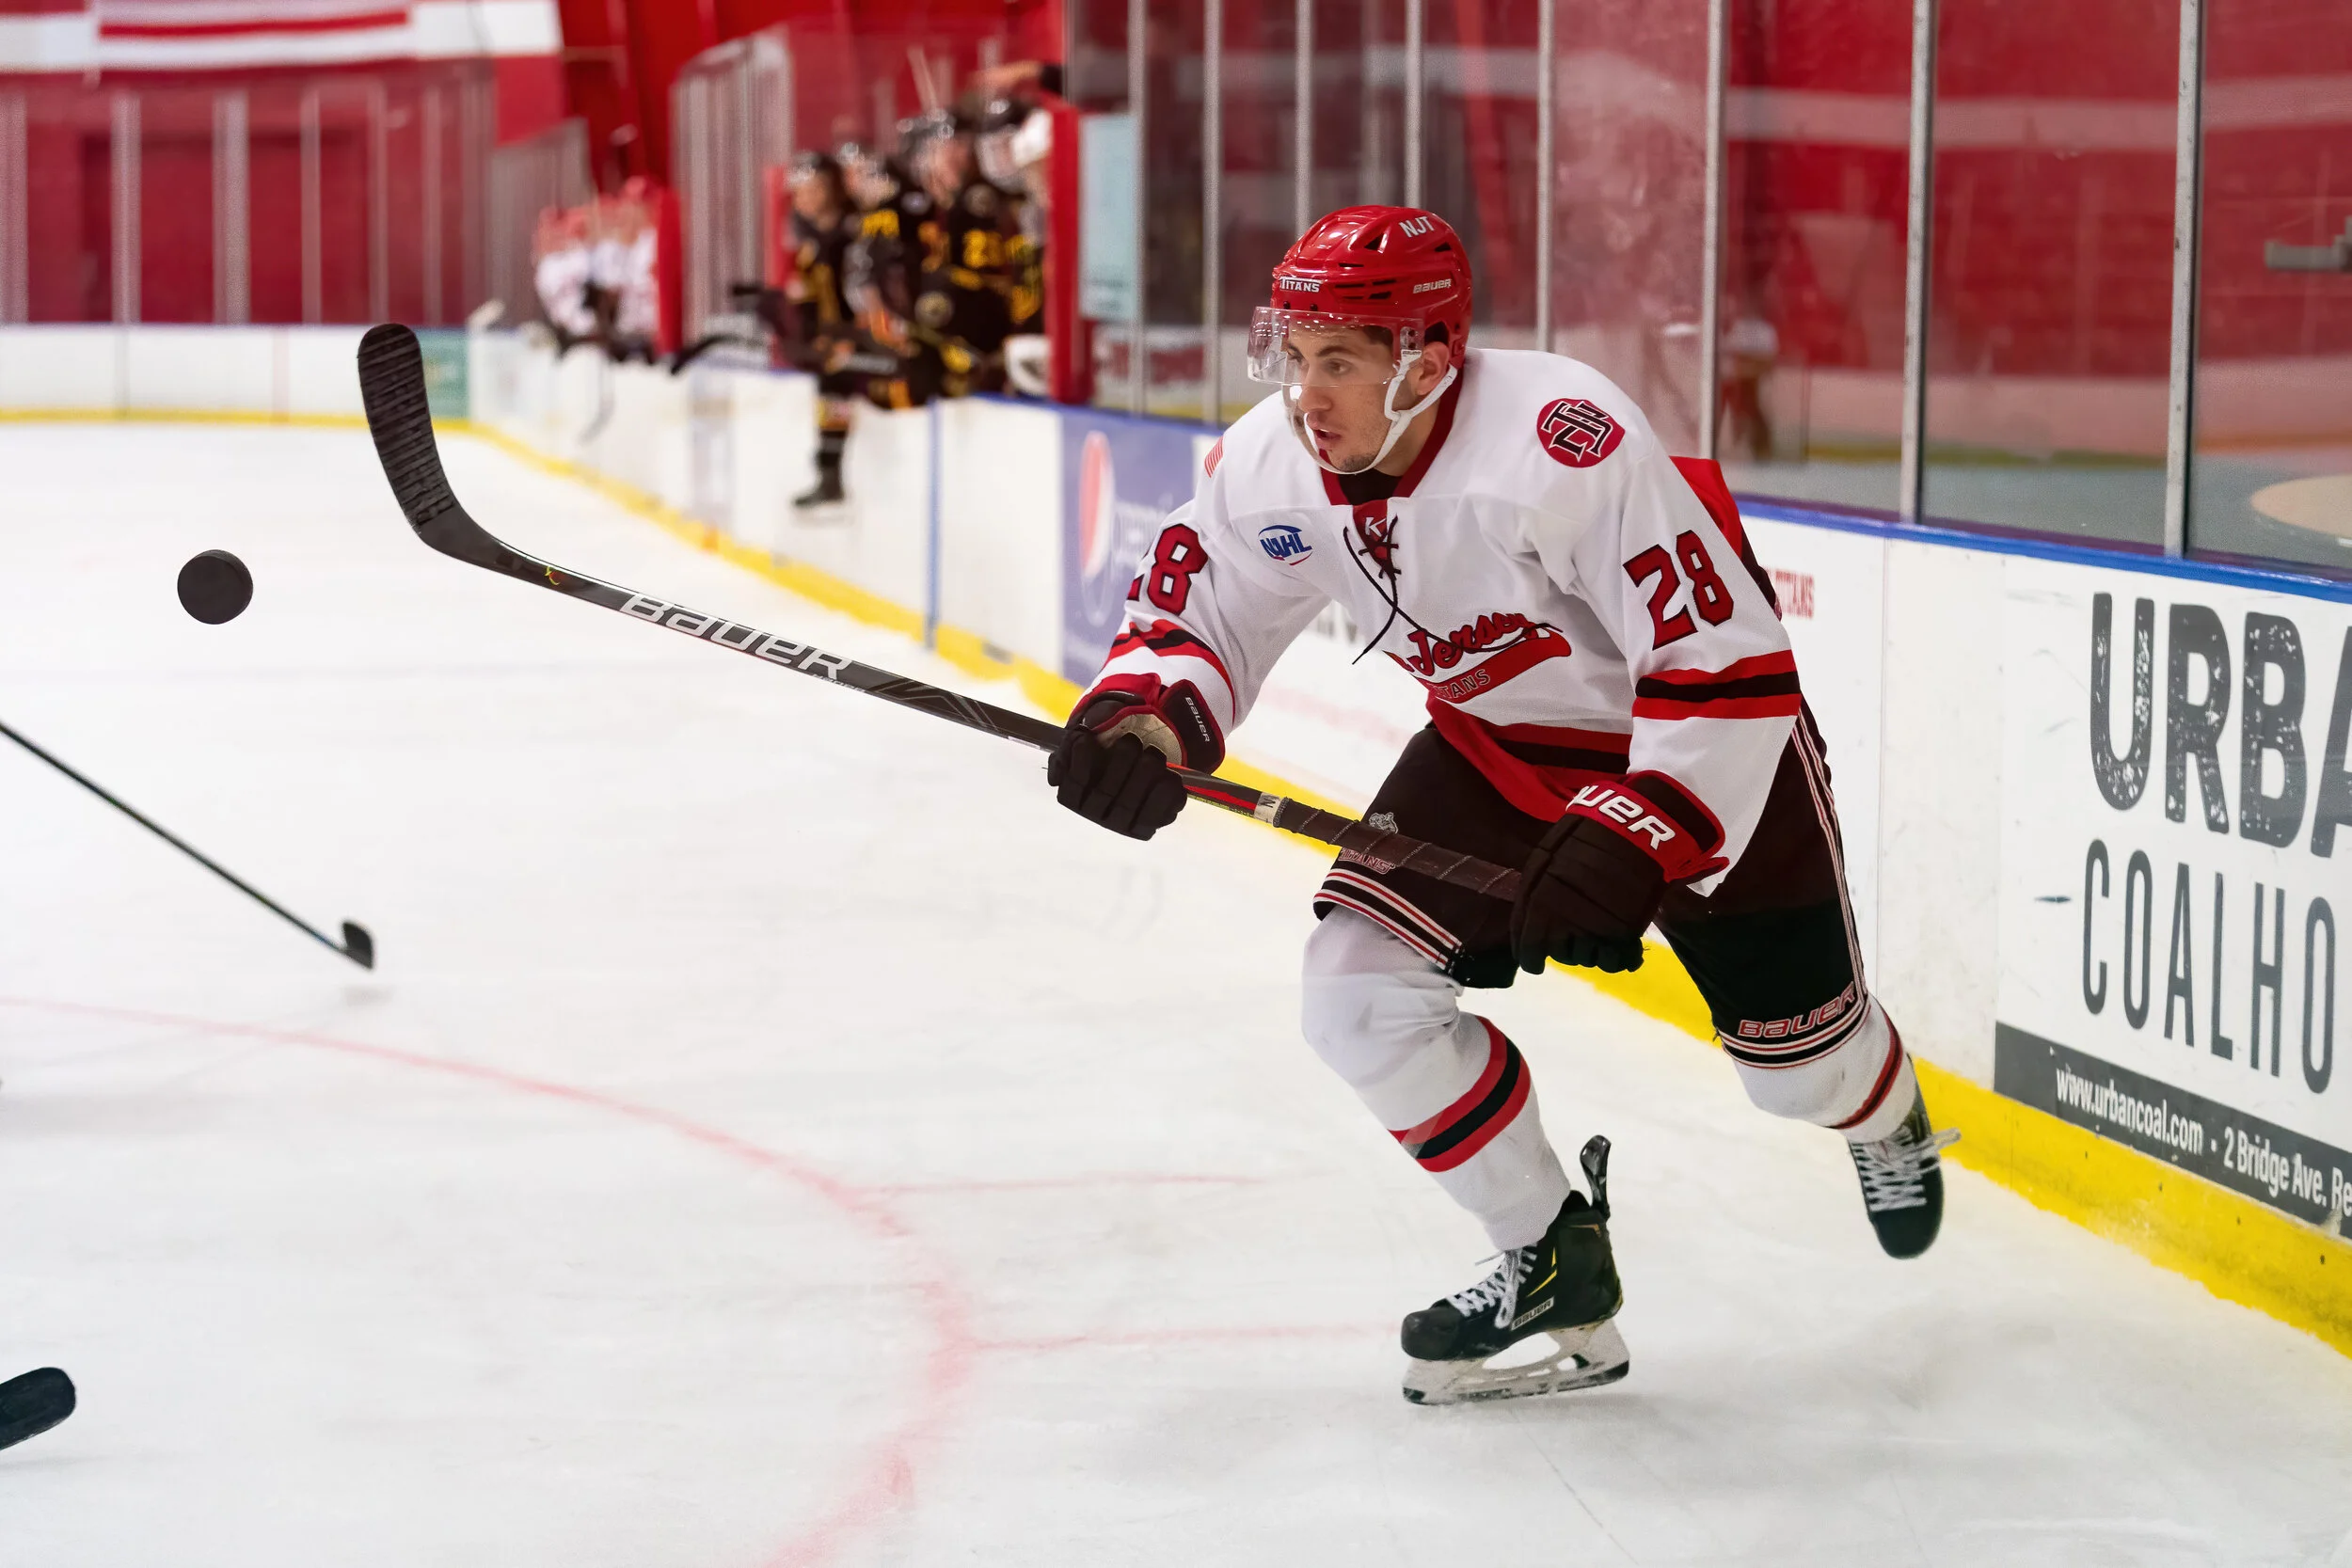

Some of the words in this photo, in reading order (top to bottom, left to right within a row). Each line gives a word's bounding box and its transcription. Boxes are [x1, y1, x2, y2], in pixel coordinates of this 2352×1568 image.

[1398, 216, 1435, 237] NJT
[1279, 276, 1324, 293] TITANS
[1259, 532, 1313, 559] NAHL
[1622, 530, 1735, 651] 28
[1565, 784, 1677, 851] UER
[2082, 839, 2336, 1094] COALHO
[2056, 1068, 2203, 1156] www.urbancoal.com
[2223, 1126, 2234, 1169] 2
[2237, 1130, 2290, 1198] Bridge
[2292, 1152, 2328, 1208] Ave.
